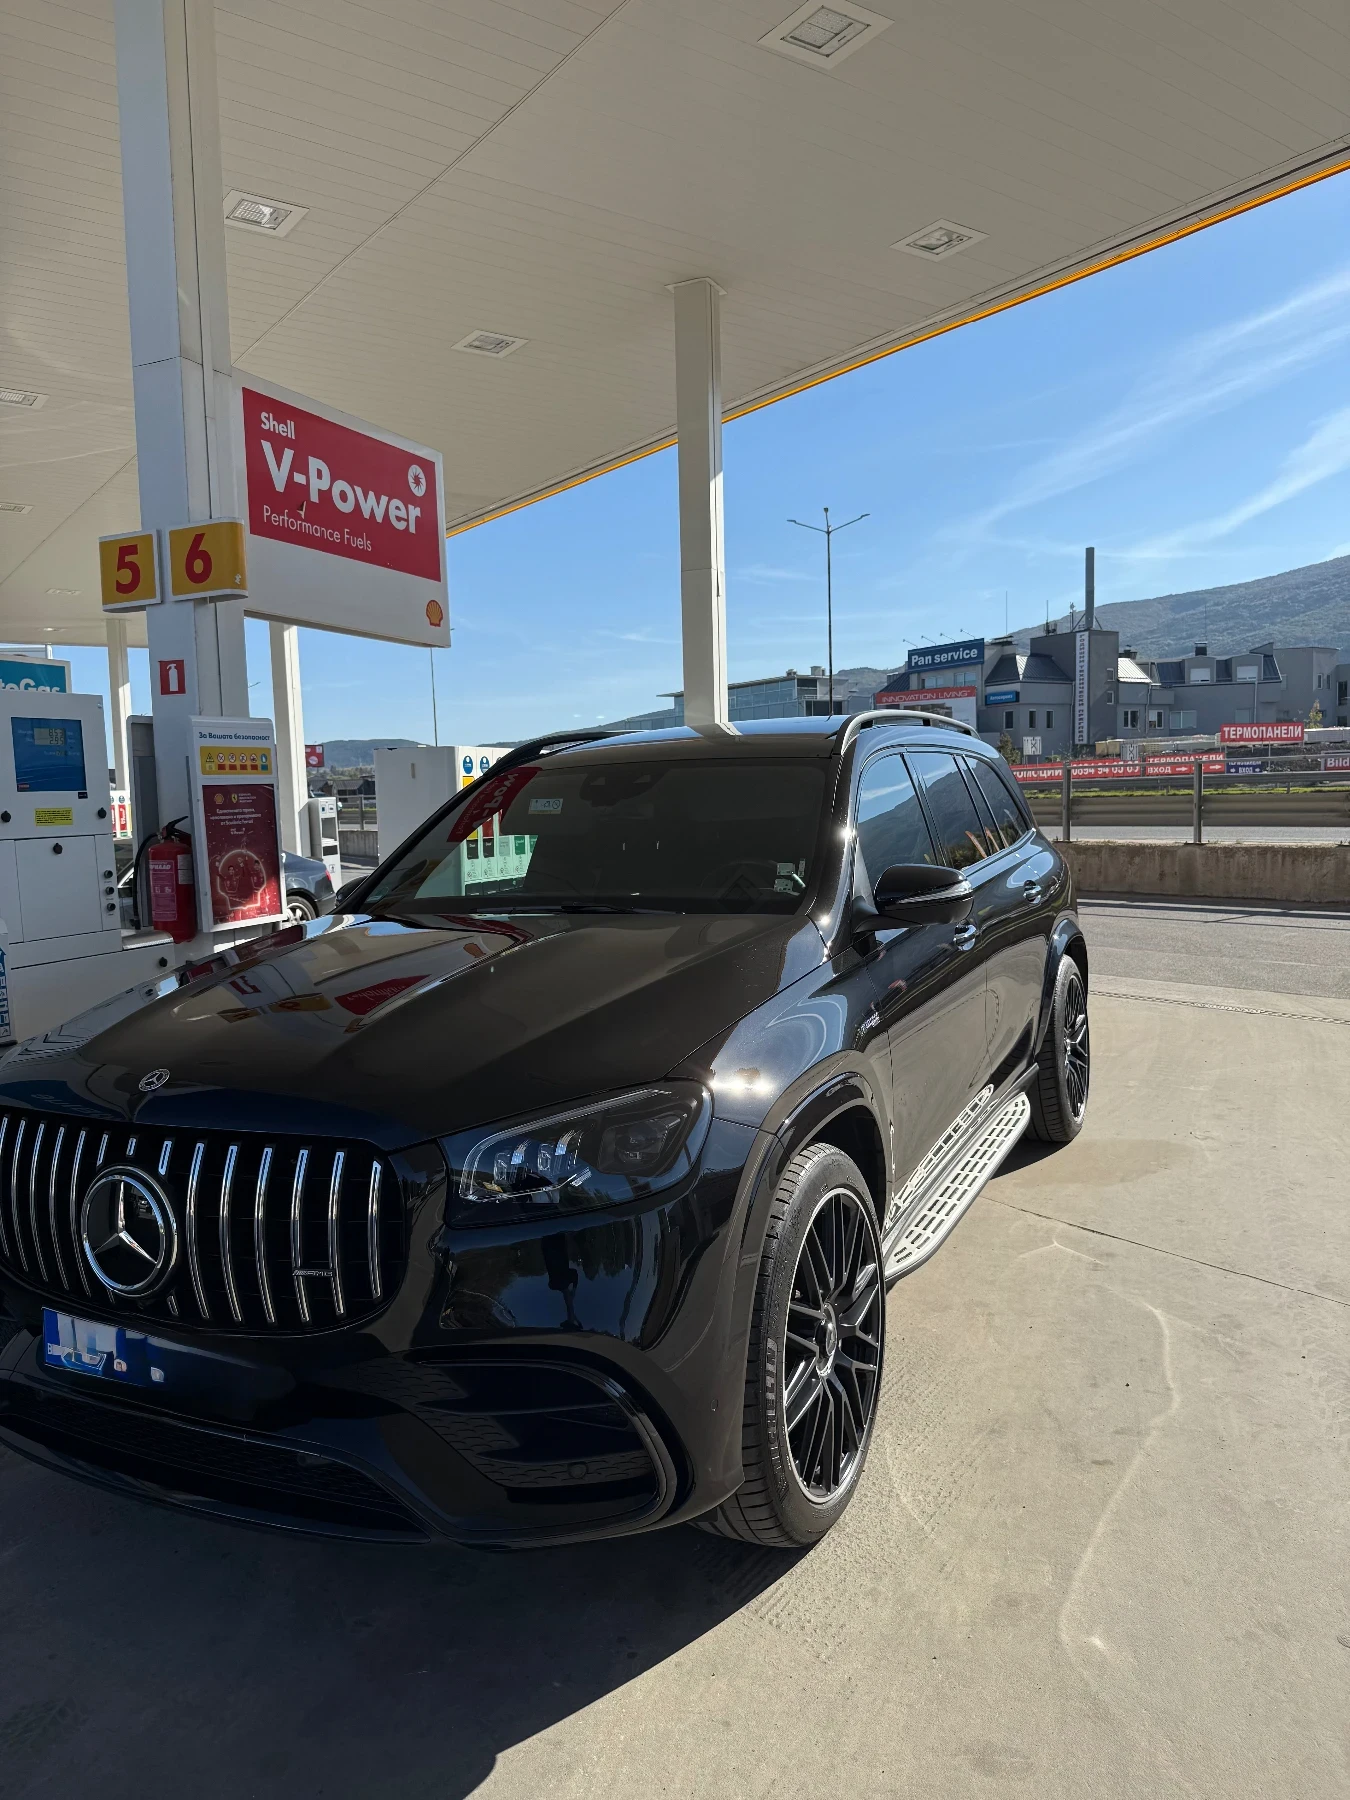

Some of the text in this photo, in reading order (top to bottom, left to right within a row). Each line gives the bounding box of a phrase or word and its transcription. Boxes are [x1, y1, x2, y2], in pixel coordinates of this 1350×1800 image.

[260, 411, 296, 440] Shell
[260, 439, 421, 534] V-Power
[263, 504, 372, 552] Performance Fuels
[115, 544, 141, 594] 5
[185, 533, 213, 584] 6
[911, 648, 978, 667] Pan service
[882, 692, 936, 703] INNOVATION
[233, 733, 270, 741] безопасност
[1223, 726, 1302, 739] ТЕРМОПАНЕЛИ
[1147, 766, 1171, 774] ВХОД
